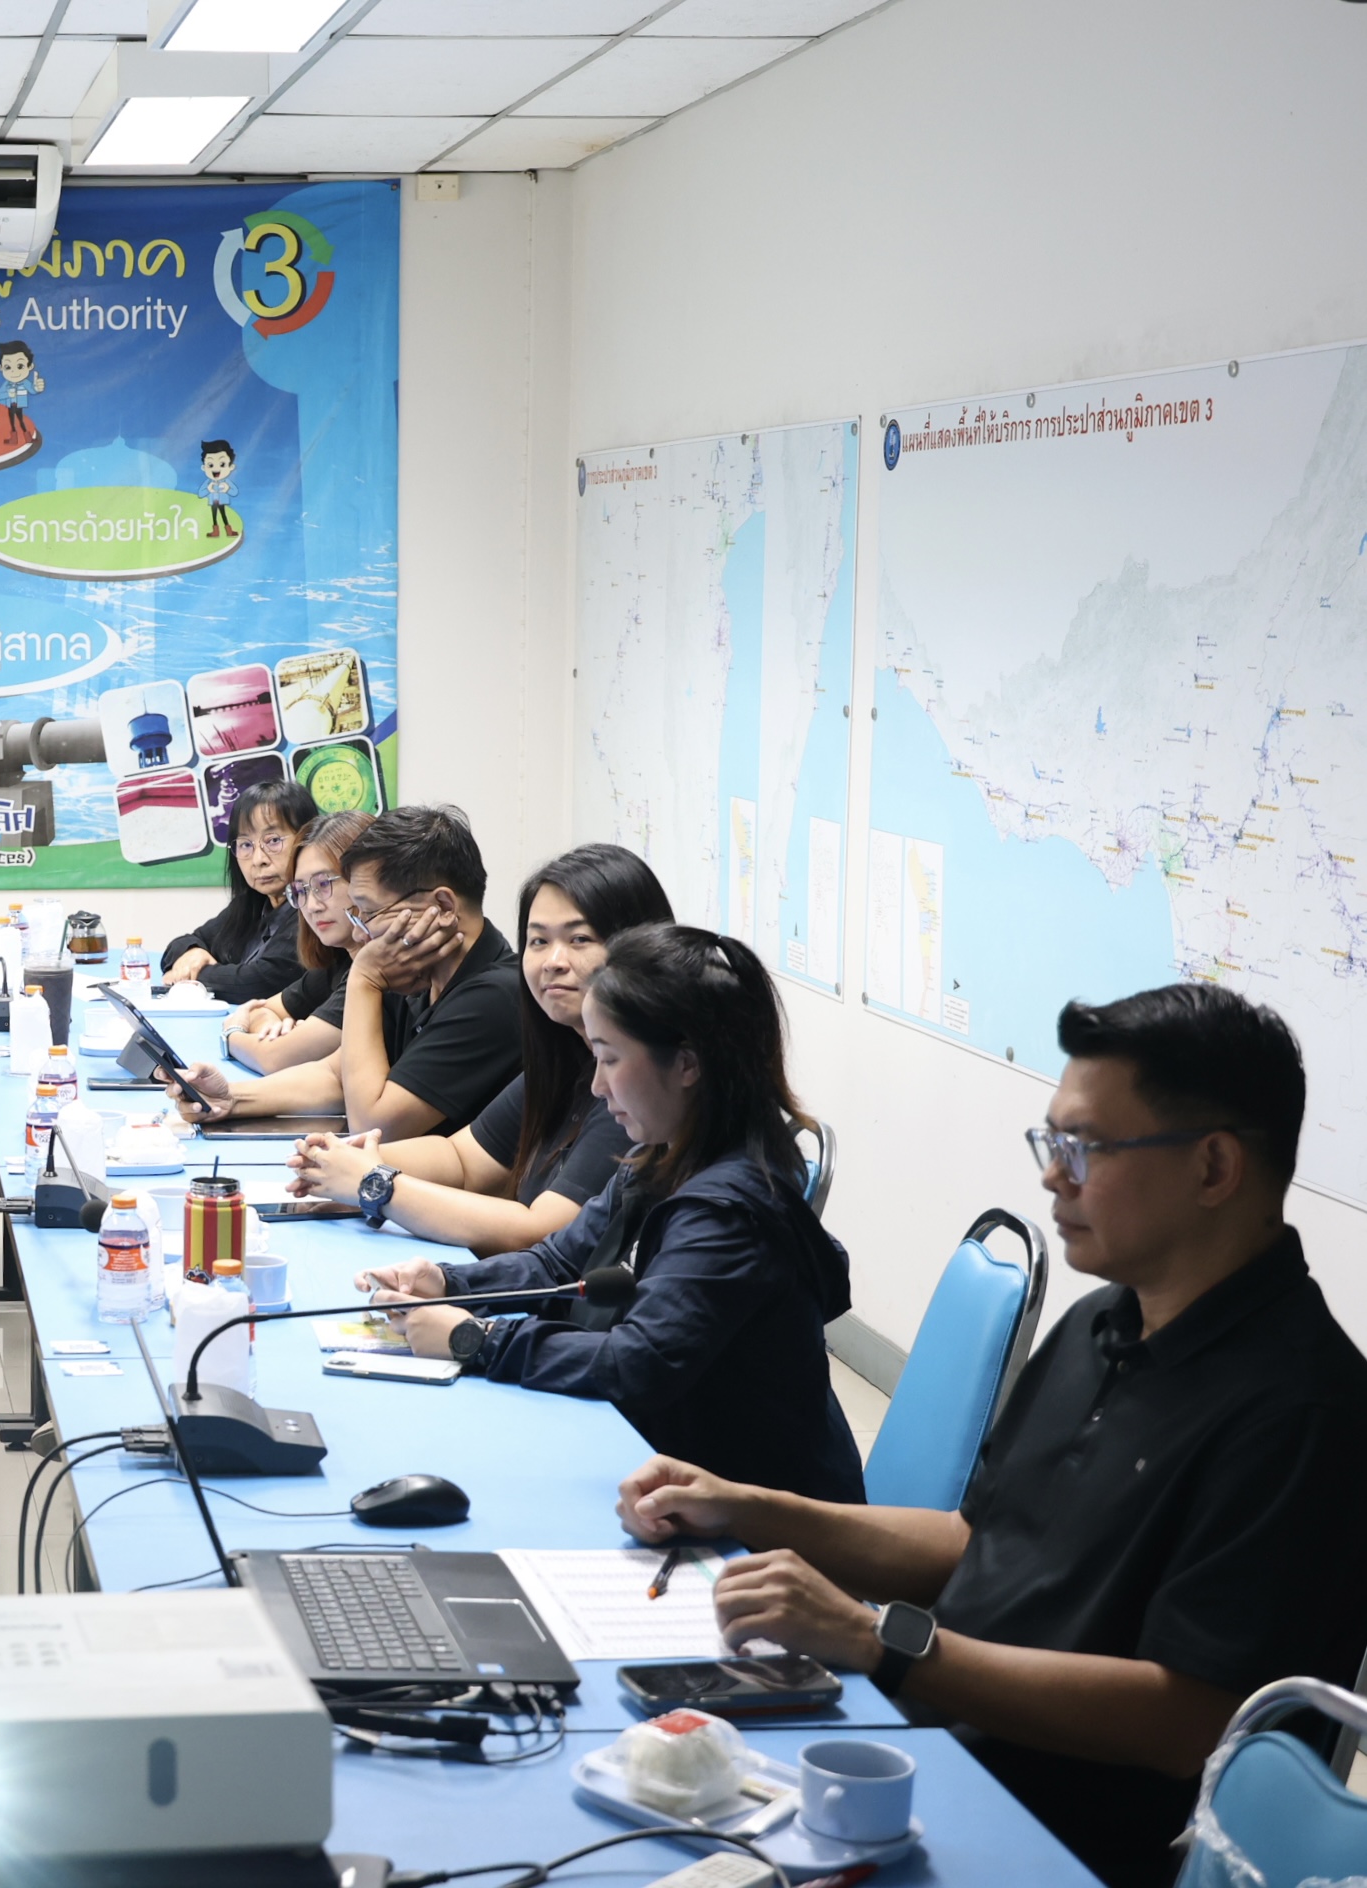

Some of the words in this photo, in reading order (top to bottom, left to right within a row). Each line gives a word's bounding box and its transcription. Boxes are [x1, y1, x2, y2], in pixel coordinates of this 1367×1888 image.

[242, 222, 307, 321] 3
[17, 297, 188, 338] Authority
[1205, 397, 1214, 422] 3
